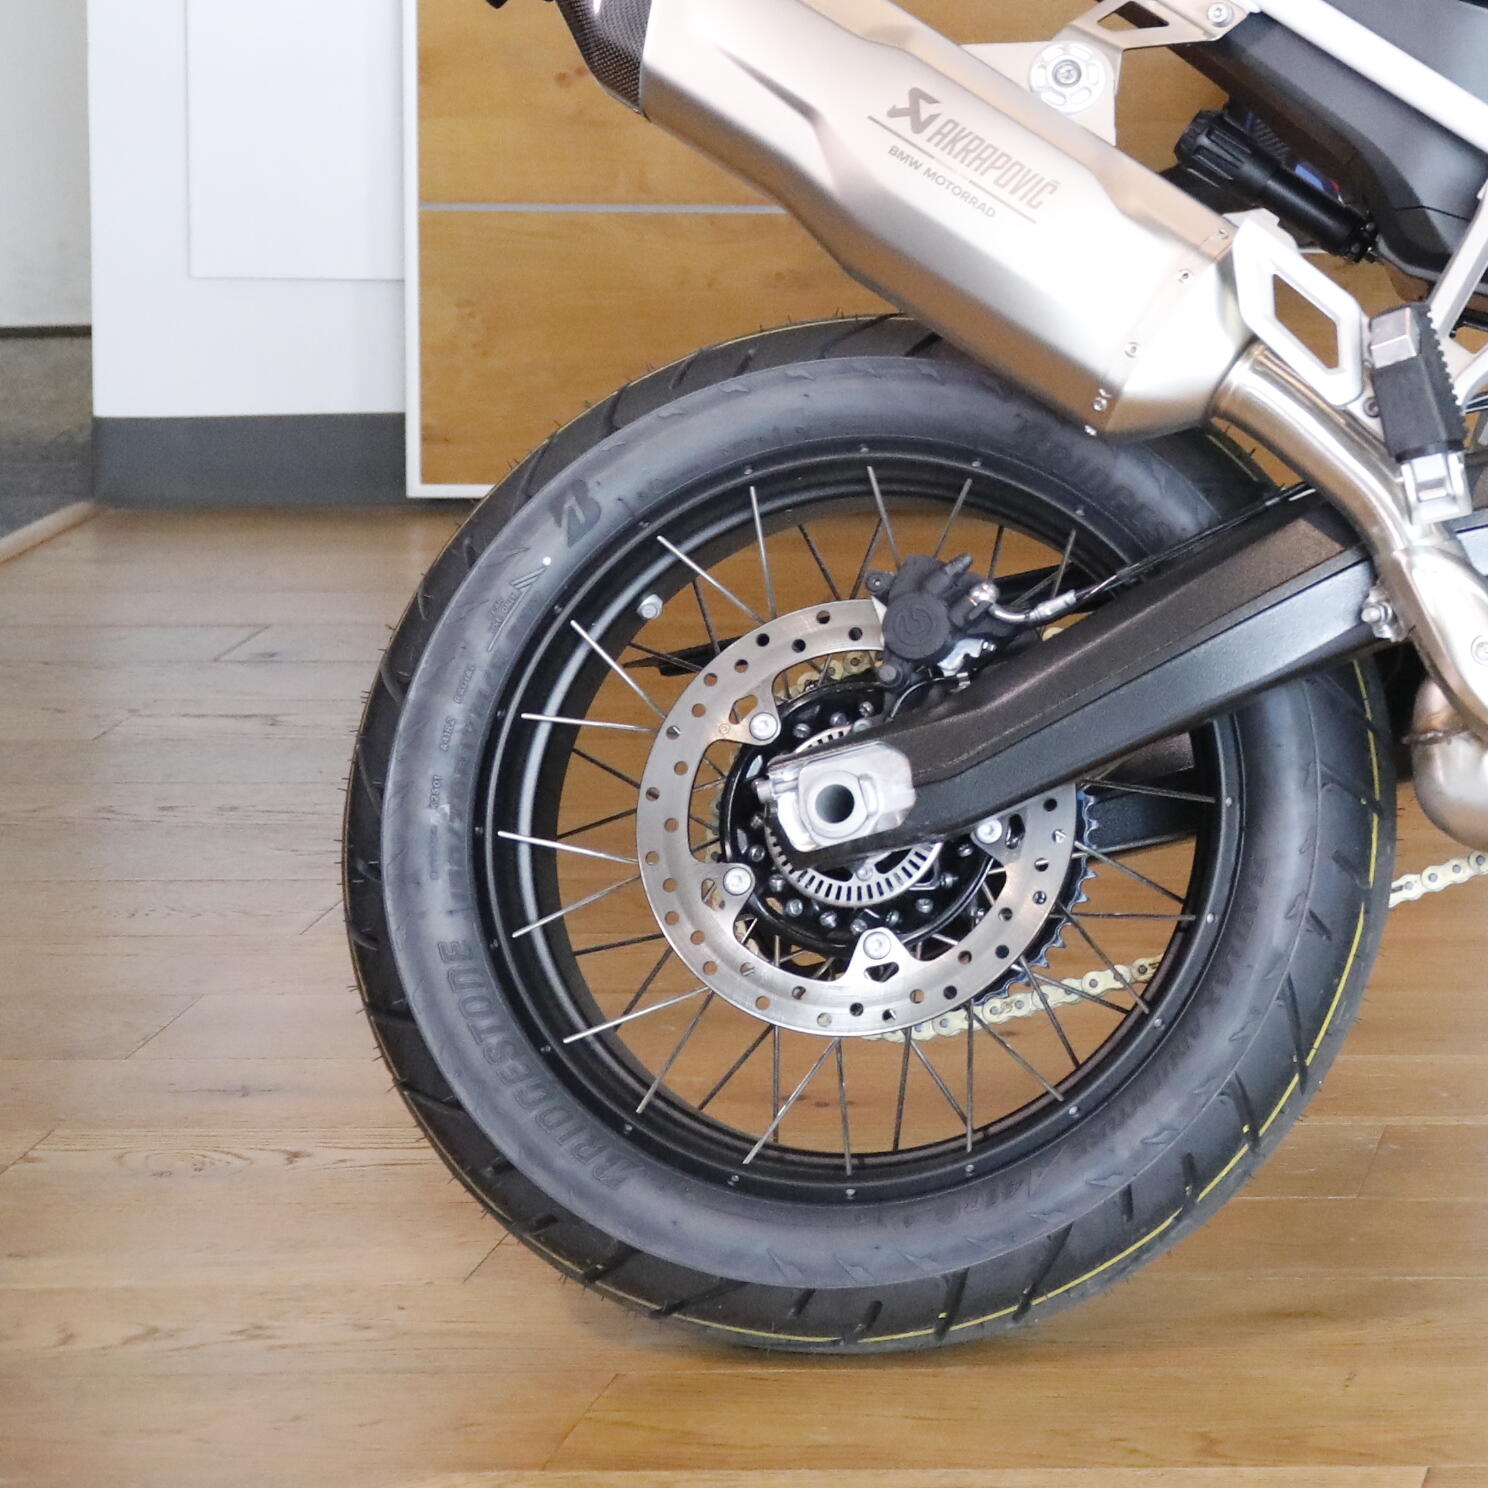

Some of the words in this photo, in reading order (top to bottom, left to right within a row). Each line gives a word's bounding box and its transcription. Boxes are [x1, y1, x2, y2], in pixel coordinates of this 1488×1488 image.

[887, 144, 923, 172] BMW
[922, 166, 997, 220] MOTORRAD
[437, 939, 646, 1193] BRIDGESTONE
